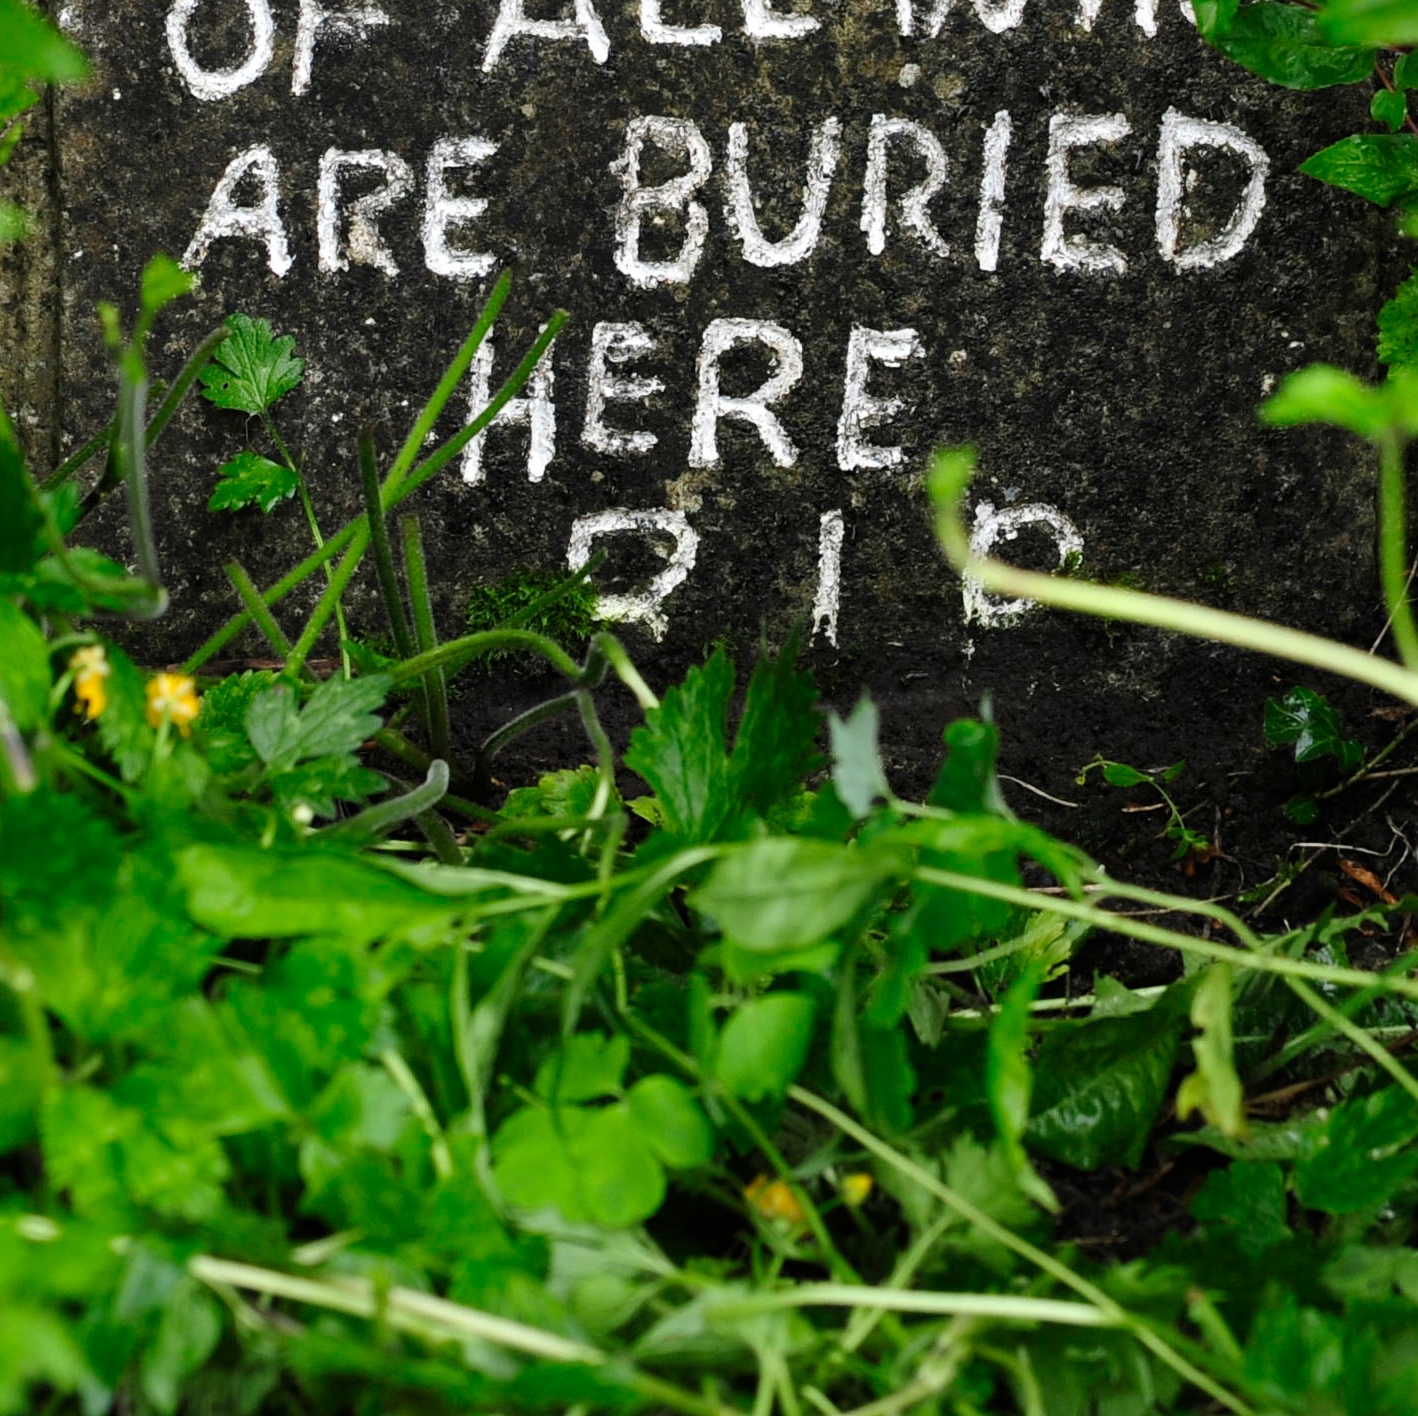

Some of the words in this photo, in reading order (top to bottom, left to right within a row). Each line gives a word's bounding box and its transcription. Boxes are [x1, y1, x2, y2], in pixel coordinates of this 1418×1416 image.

[180, 136, 501, 278] ARE
[609, 106, 1272, 290] BURIED
[460, 317, 927, 484] HERE
